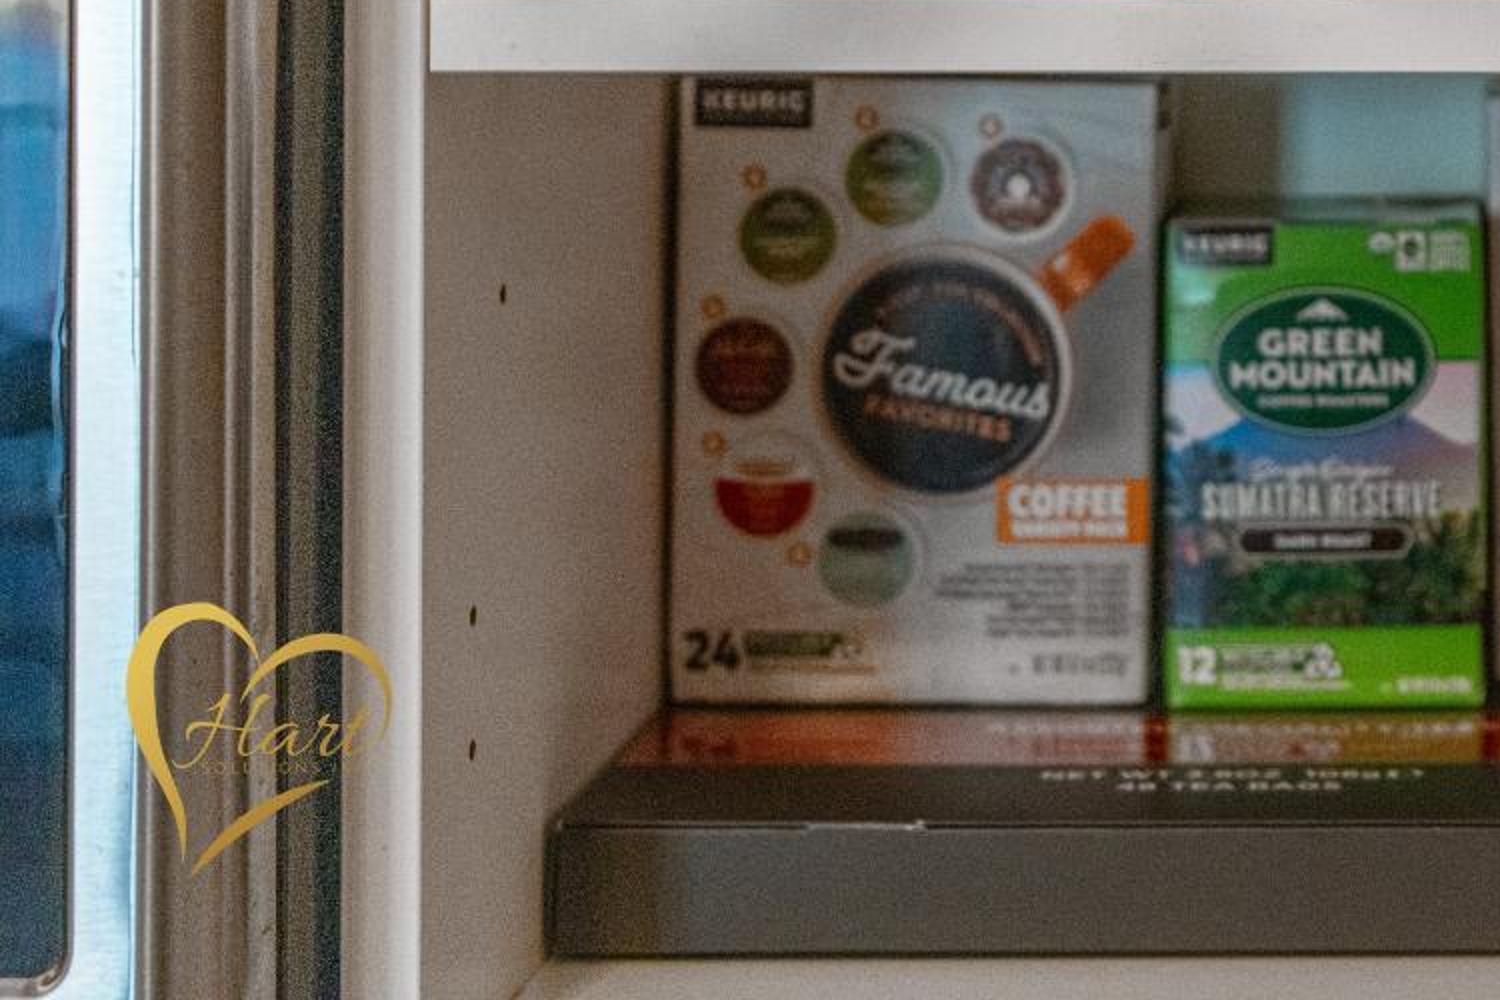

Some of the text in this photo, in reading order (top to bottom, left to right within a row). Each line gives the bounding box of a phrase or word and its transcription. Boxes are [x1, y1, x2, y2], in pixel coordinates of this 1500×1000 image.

[1257, 326, 1384, 358] GREEN
[833, 328, 1050, 421] Famous
[1229, 358, 1418, 390] MOUNTAIN
[1007, 484, 1125, 518] COFFEE
[683, 629, 741, 672] 24
